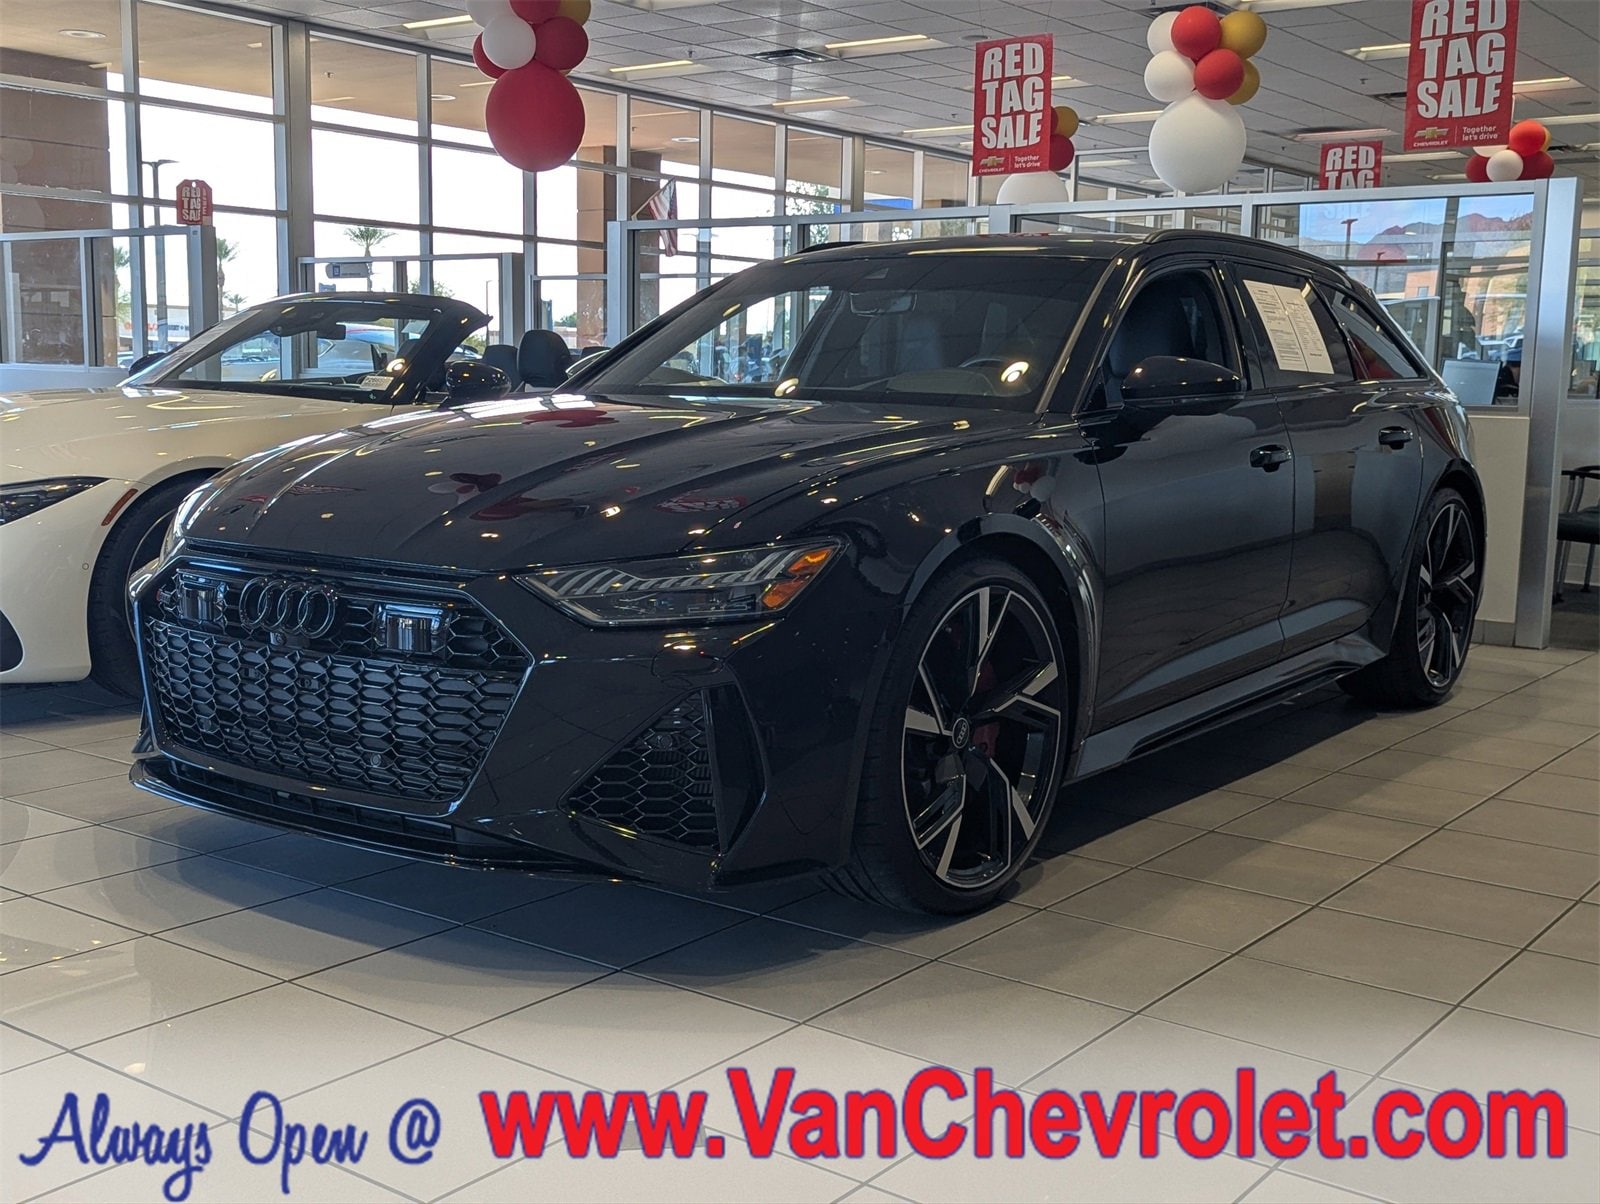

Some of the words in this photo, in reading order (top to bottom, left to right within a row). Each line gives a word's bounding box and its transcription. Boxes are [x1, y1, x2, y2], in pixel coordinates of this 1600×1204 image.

[1420, 0, 1507, 38] RED
[982, 43, 1044, 80] RED
[1419, 32, 1506, 79] TAG
[982, 76, 1044, 115] TAG
[1417, 75, 1502, 118] SALE
[981, 112, 1043, 149] SALE
[1462, 125, 1497, 134] Together
[1462, 133, 1478, 141] let's
[1479, 132, 1498, 140] drive
[1014, 154, 1040, 163] Together
[1325, 145, 1376, 171] RED
[1325, 169, 1375, 190] TAG
